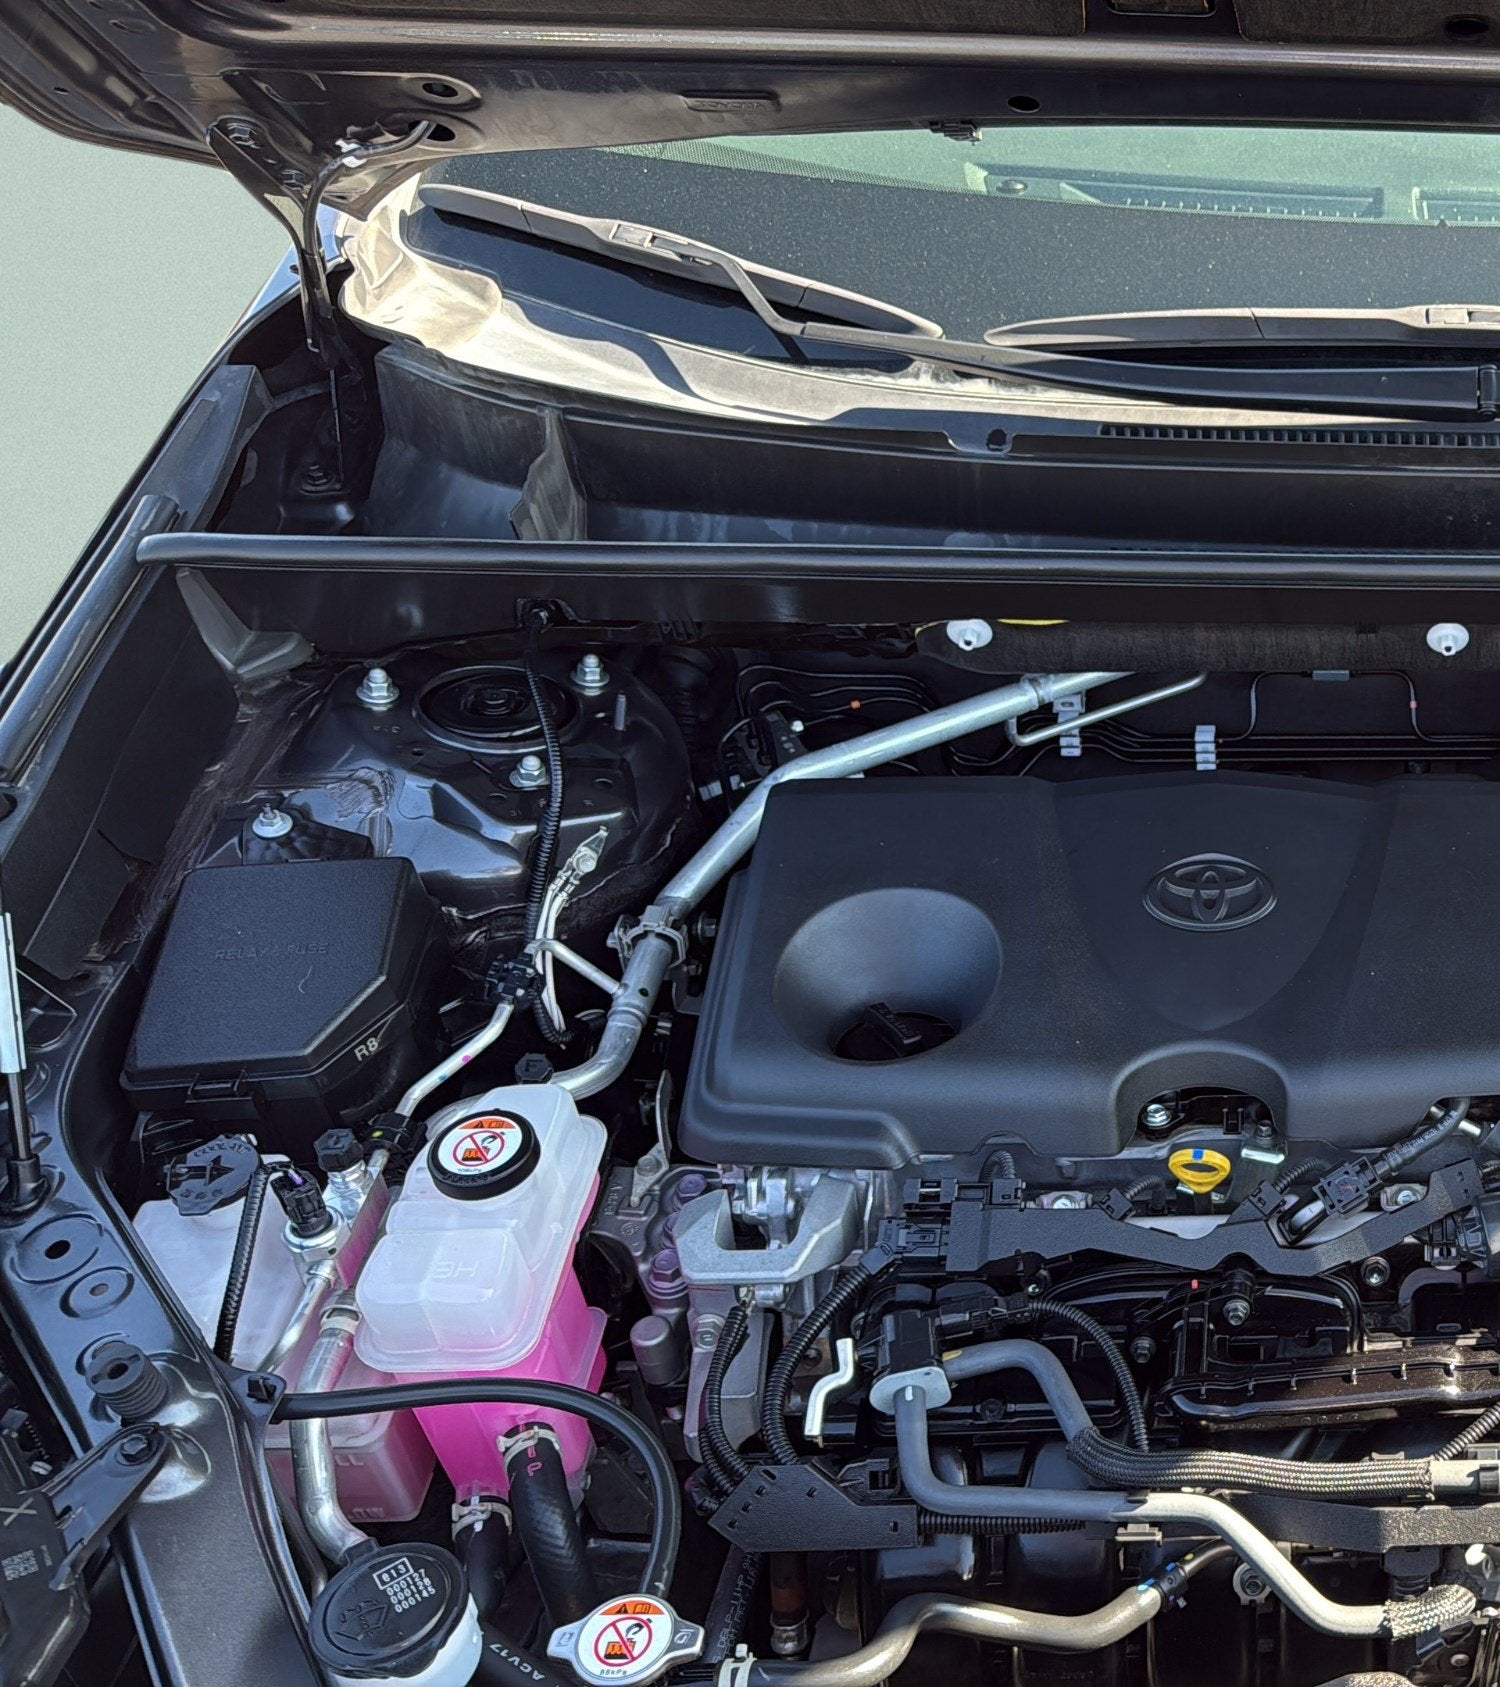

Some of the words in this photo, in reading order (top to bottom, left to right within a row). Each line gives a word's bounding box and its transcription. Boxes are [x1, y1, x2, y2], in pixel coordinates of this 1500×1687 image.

[214, 947, 268, 960] RELAY
[287, 942, 330, 955] FUSE
[353, 1036, 379, 1062] R8
[380, 1563, 407, 1583] e13
[385, 1568, 426, 1597] 000127
[389, 1578, 432, 1605] 000128
[394, 1586, 437, 1614] 000145
[488, 1642, 546, 1681] ACV17
